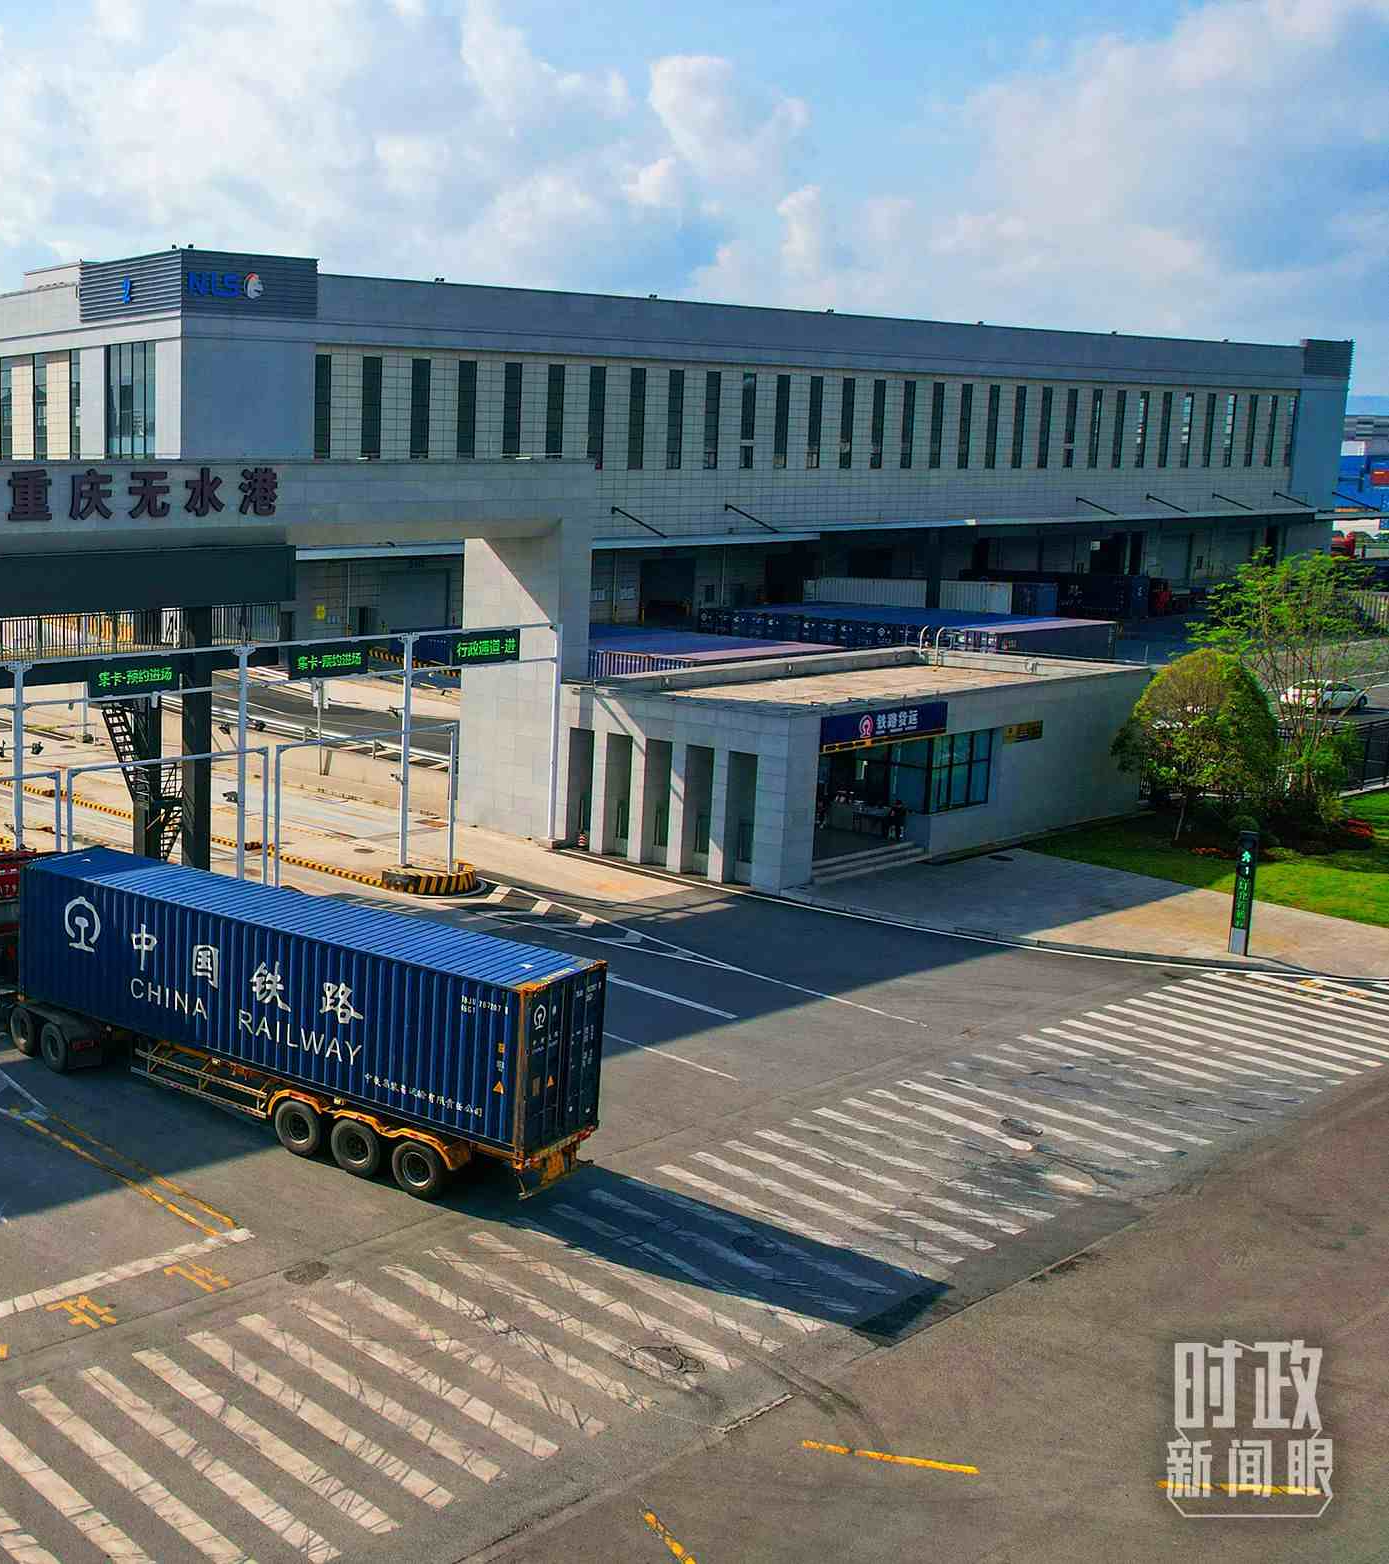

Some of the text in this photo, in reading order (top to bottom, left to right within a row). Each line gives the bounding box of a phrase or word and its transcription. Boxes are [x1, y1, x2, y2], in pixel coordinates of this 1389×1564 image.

[188, 271, 240, 298] NLS
[131, 923, 364, 1024] 中国铁路
[130, 978, 362, 1065] CHINA RAILWAY
